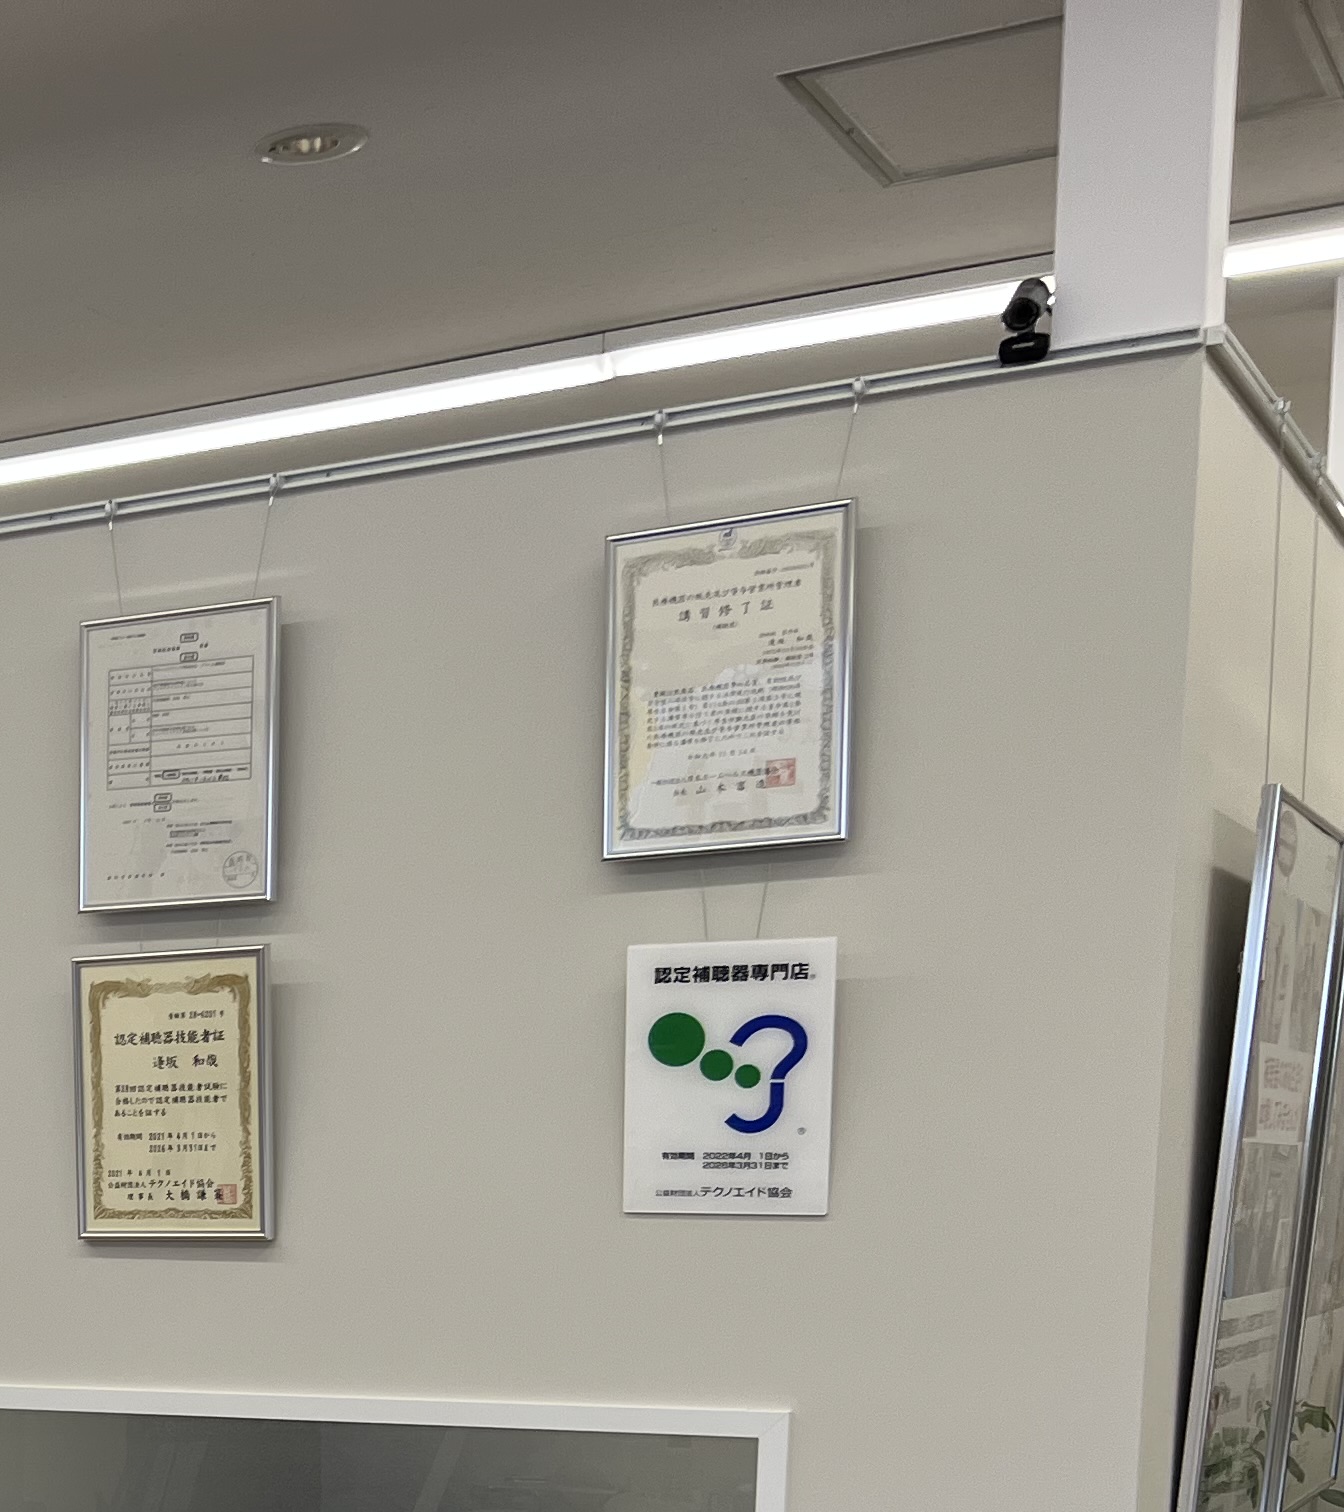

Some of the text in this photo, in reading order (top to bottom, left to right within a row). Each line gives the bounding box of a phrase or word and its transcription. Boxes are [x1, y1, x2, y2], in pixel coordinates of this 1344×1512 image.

[654, 962, 810, 985] 認定補聴器専門店
[113, 1028, 226, 1046] 認定補聴器技能者証
